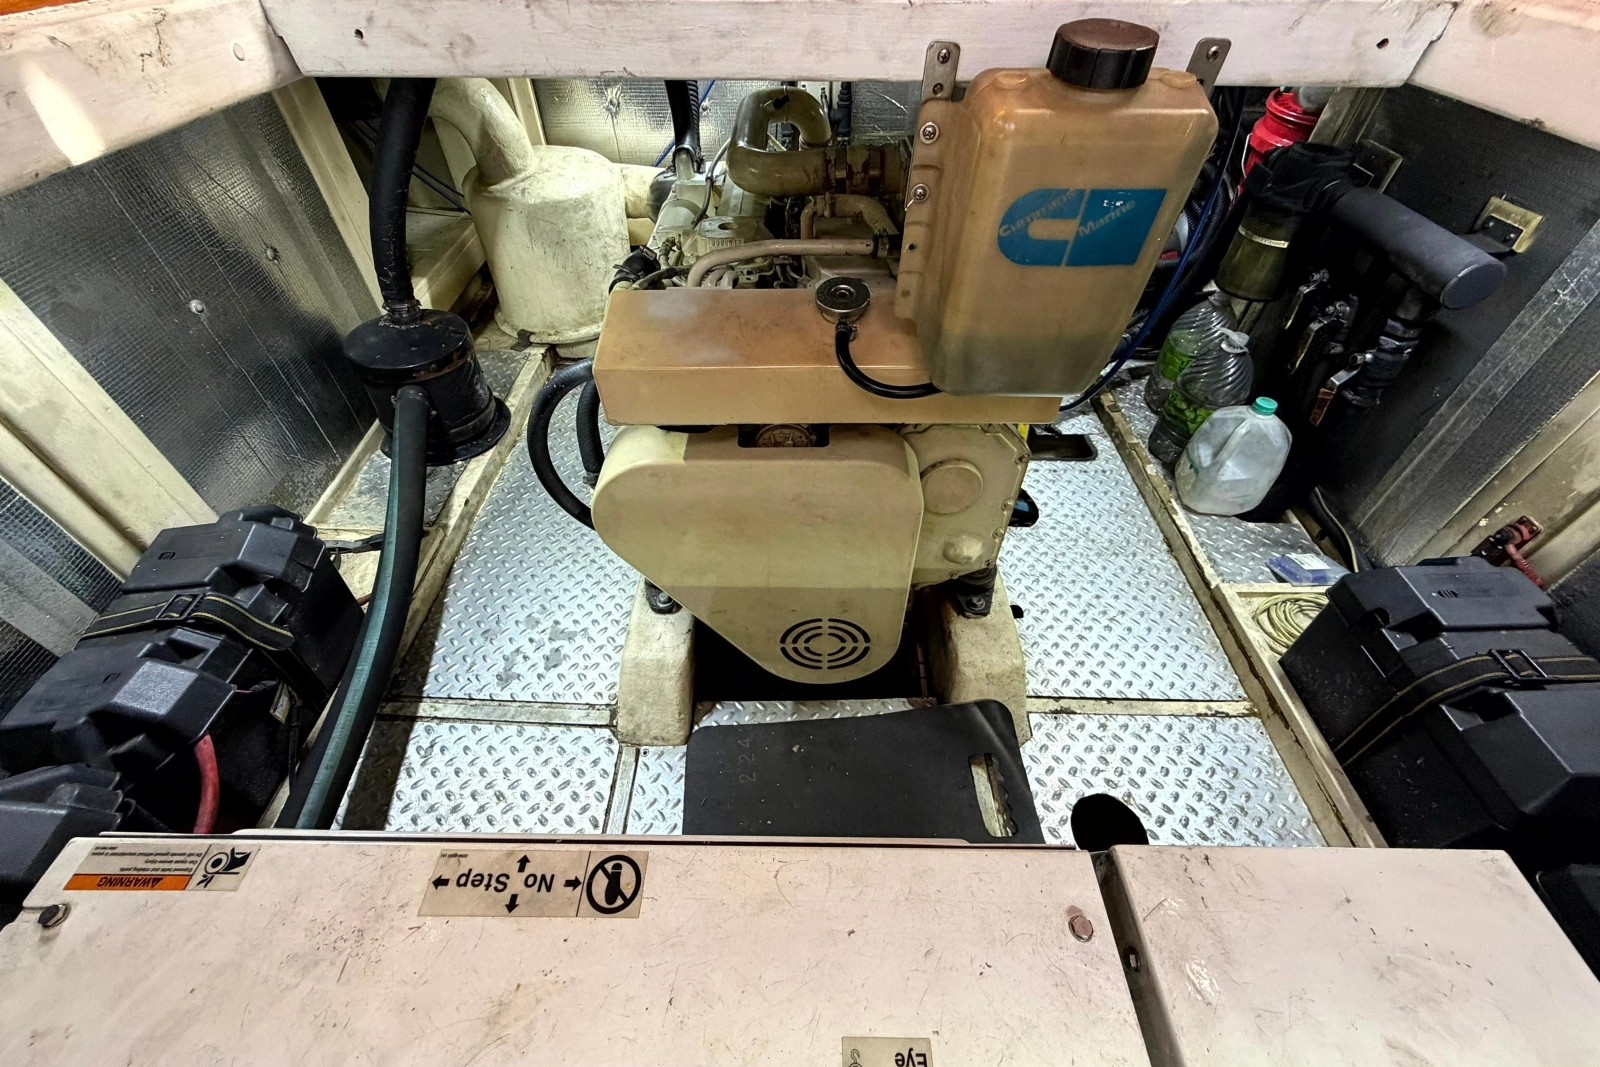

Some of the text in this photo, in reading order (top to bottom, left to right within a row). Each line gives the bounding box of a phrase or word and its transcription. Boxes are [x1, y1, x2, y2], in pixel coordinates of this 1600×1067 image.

[1076, 199, 1136, 238] Marine
[97, 876, 154, 888] WARNING
[455, 868, 555, 892] No Step
[894, 1047, 928, 1067] Eye
